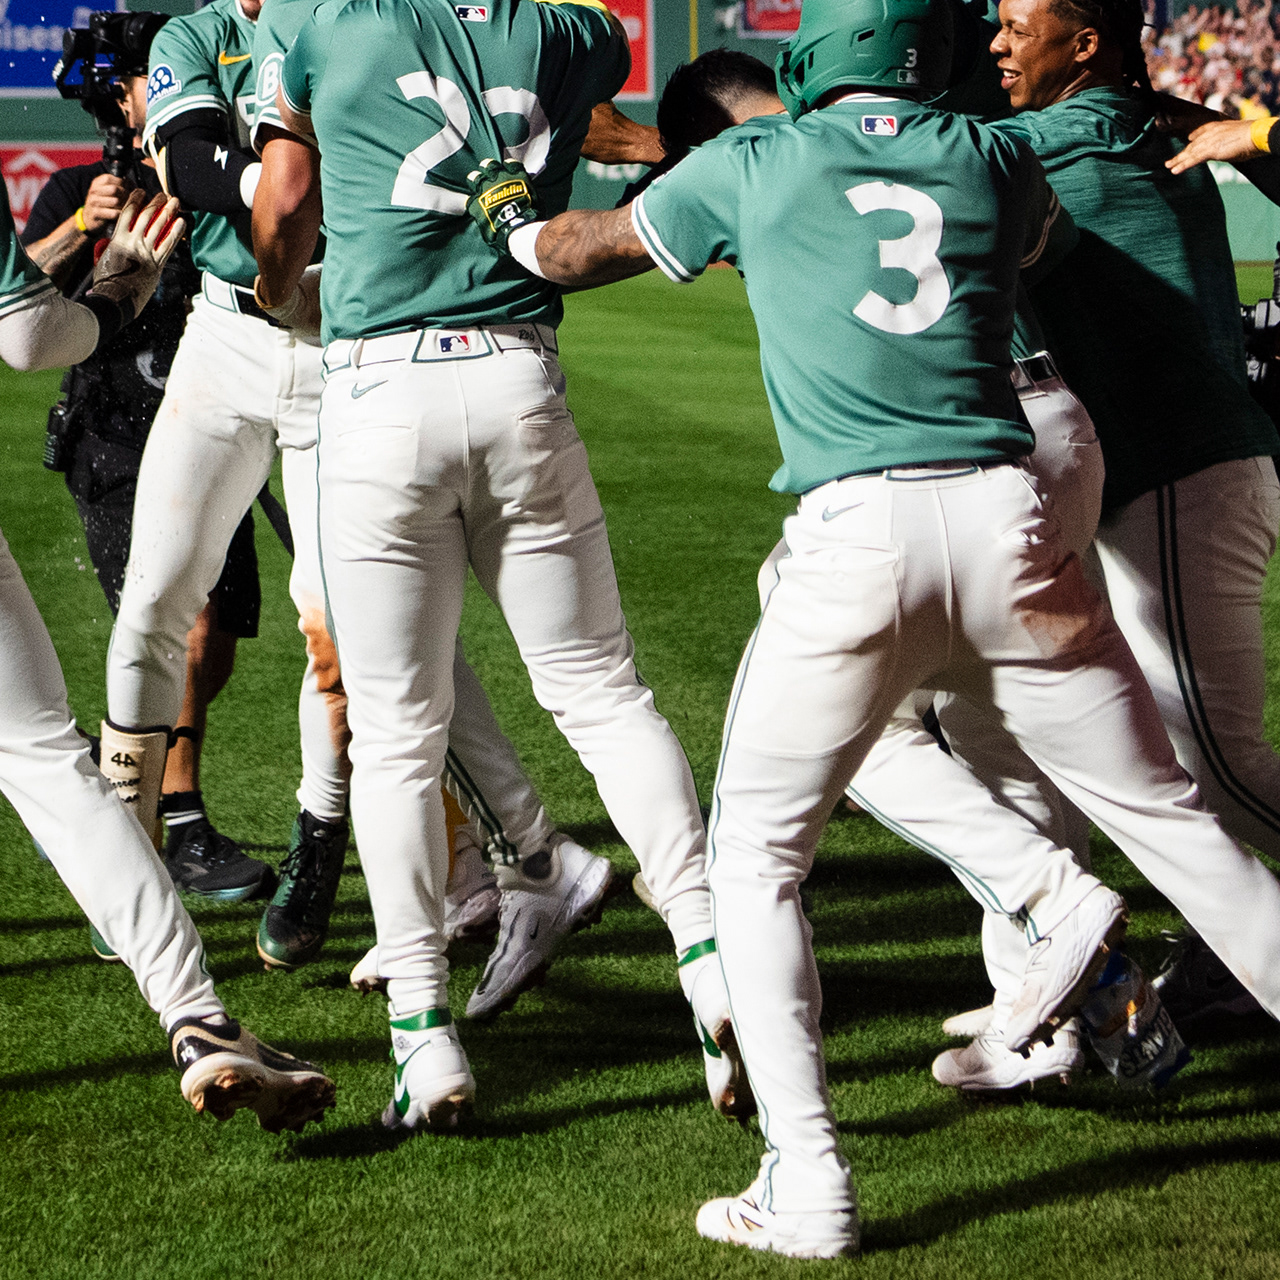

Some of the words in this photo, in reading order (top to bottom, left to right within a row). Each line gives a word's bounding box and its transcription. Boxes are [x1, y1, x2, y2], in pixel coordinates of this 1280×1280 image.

[905, 48, 918, 68] 3
[484, 184, 524, 207] Franklin
[846, 180, 952, 335] 3
[111, 751, 136, 769] 44
